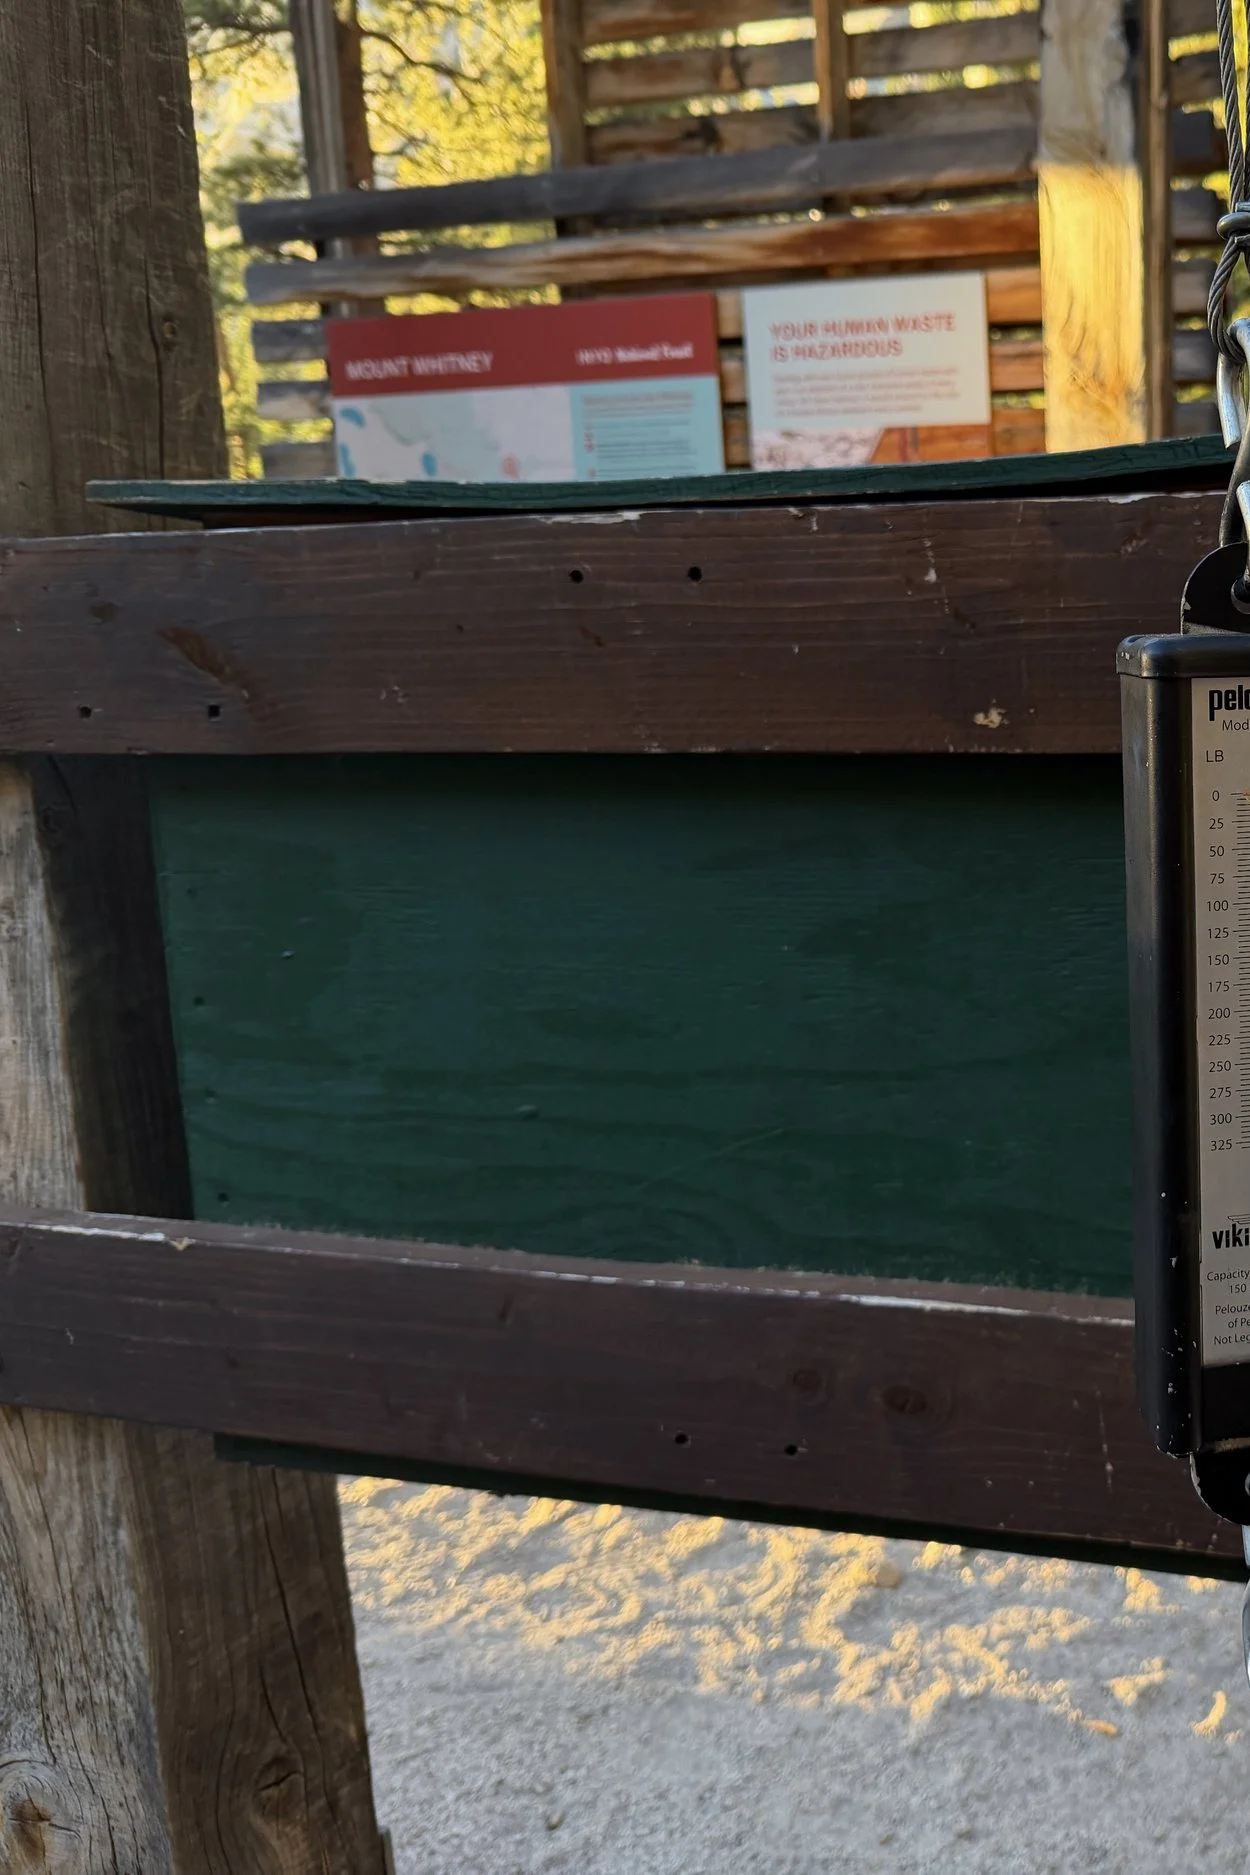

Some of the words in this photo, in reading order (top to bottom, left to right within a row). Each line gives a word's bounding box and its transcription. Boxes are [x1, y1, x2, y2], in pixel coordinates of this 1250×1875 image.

[770, 320, 817, 341] YOUR
[823, 317, 889, 338] HUMAN
[893, 312, 956, 333] WASTE
[771, 344, 790, 363] IS
[793, 339, 903, 361] HAZARDOUS
[345, 356, 409, 381] MOUNT
[411, 350, 493, 376] WHITNEY
[1206, 750, 1224, 763] LB
[1212, 790, 1219, 801] 0
[1209, 818, 1224, 829] 25
[1209, 845, 1224, 857] 50
[1210, 873, 1224, 884] 75
[1207, 900, 1228, 912] 100
[1208, 927, 1229, 938] 125
[1208, 954, 1229, 966] 150
[1208, 981, 1229, 992] 175
[1208, 1007, 1230, 1019] 200
[1208, 1034, 1231, 1046] 225
[1209, 1060, 1231, 1073] 250
[1209, 1086, 1231, 1099] 275
[1210, 1113, 1232, 1125] 300
[1211, 1139, 1232, 1151] 325
[1207, 1269, 1250, 1282] Capacity
[1229, 1283, 1247, 1294] 150
[1228, 1318, 1239, 1329] of
[1213, 1333, 1232, 1345] Not
